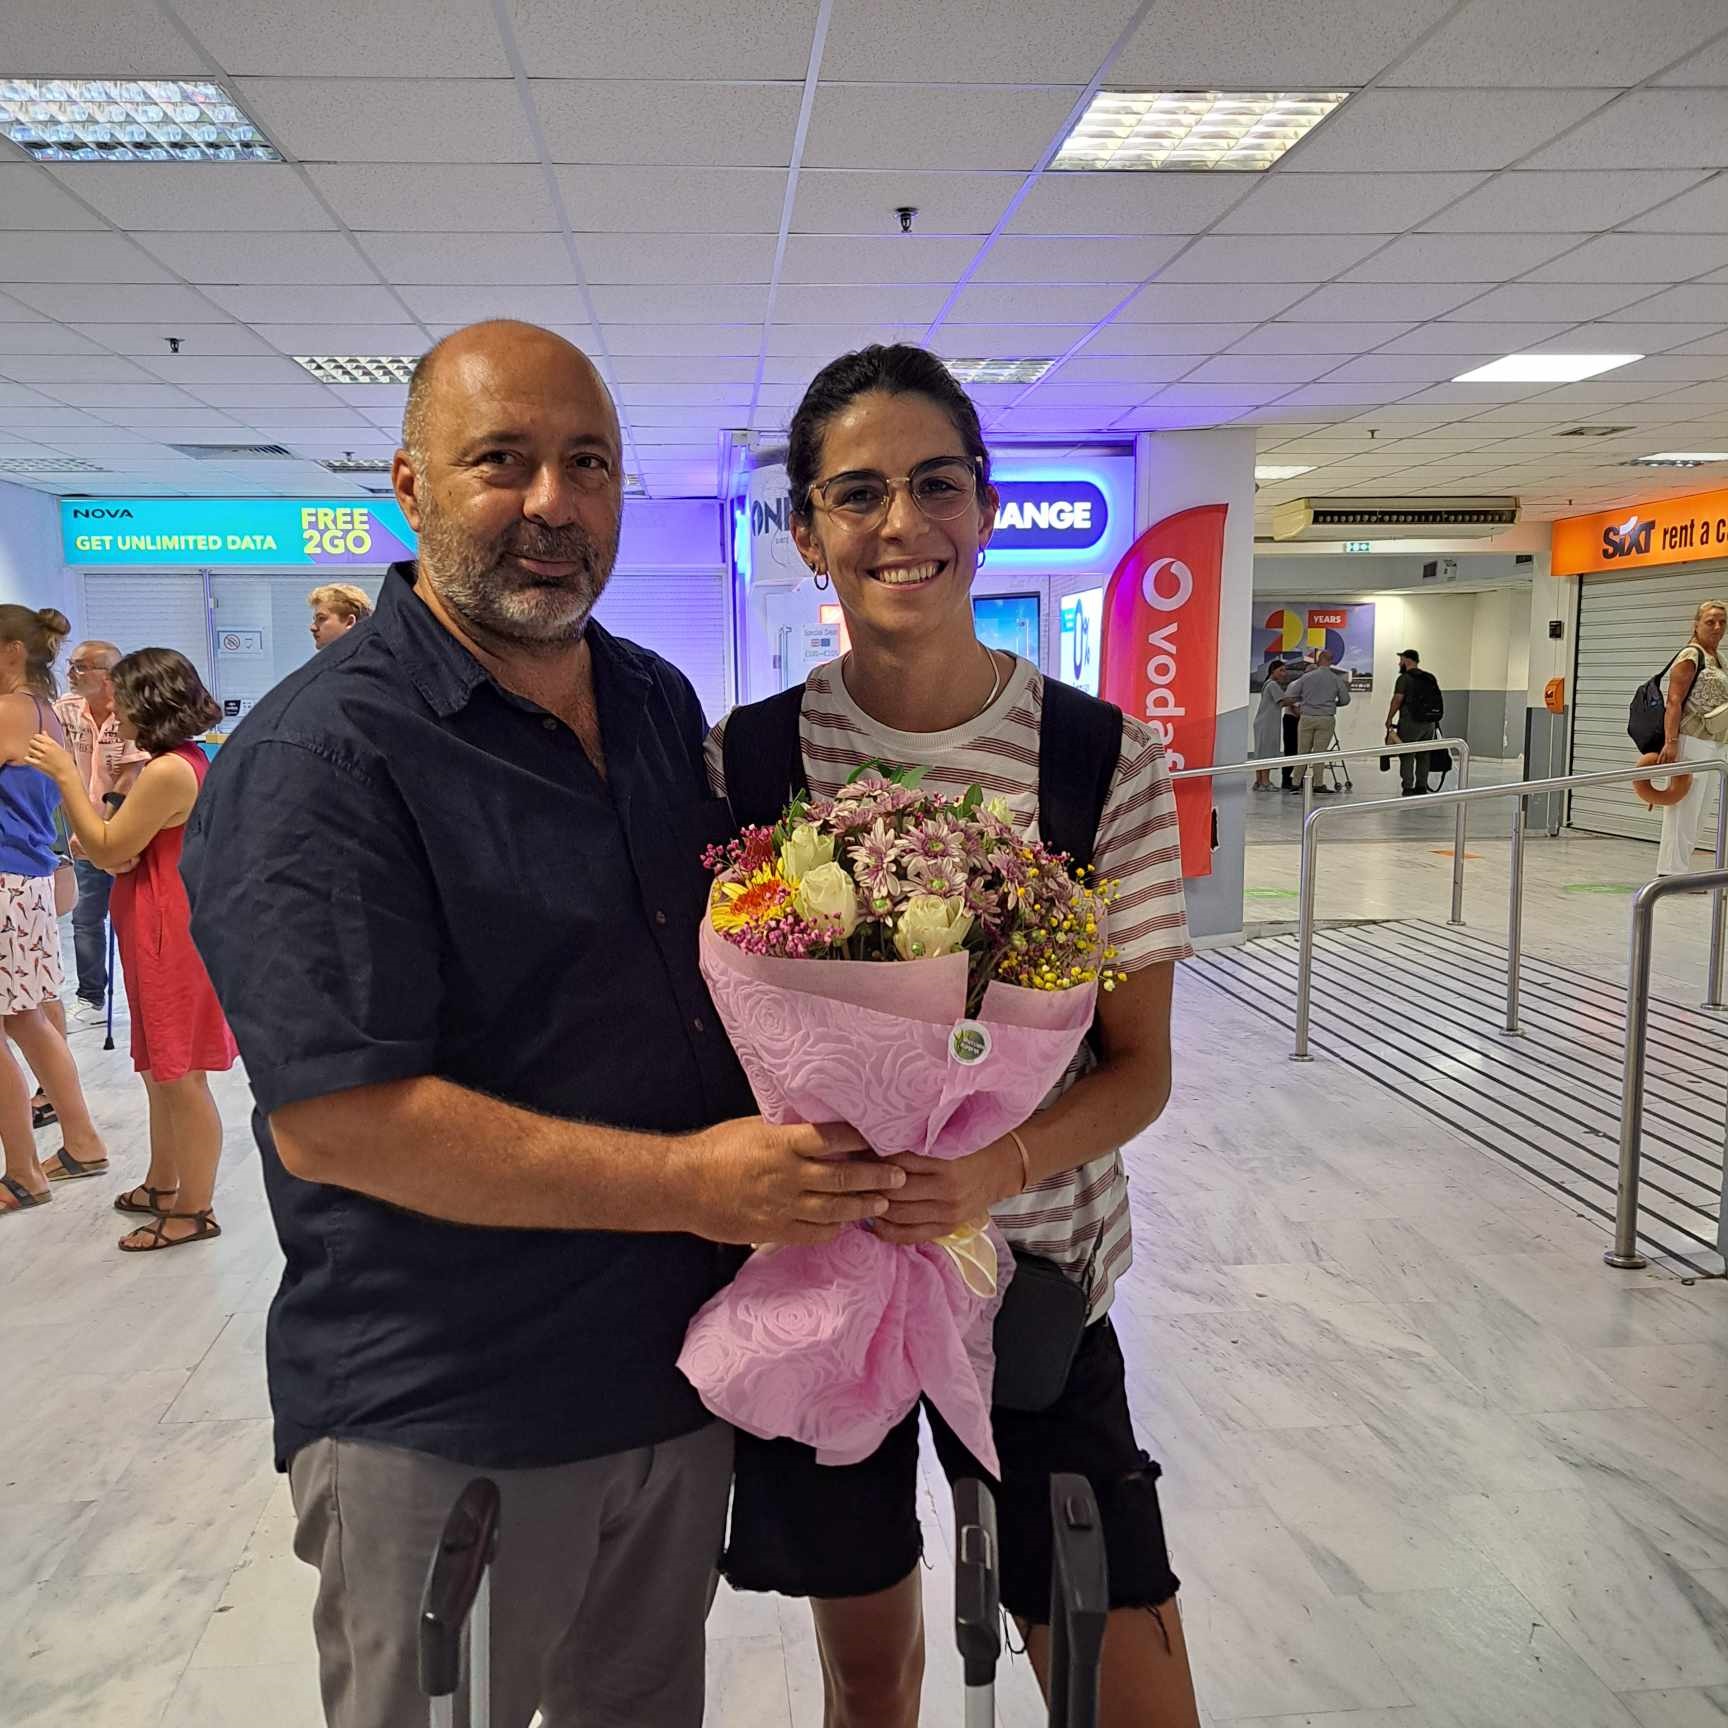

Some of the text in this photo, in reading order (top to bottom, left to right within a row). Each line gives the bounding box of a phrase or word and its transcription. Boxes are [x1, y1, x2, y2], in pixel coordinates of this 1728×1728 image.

[73, 508, 134, 519] NOVA
[301, 507, 370, 530] FREE
[76, 535, 277, 551] GET UNLIMITED DATA
[303, 529, 372, 554] 2GO
[1662, 518, 1695, 551] rent
[1700, 520, 1710, 546] a
[1715, 518, 1728, 547] c
[1313, 615, 1343, 624] YEARS
